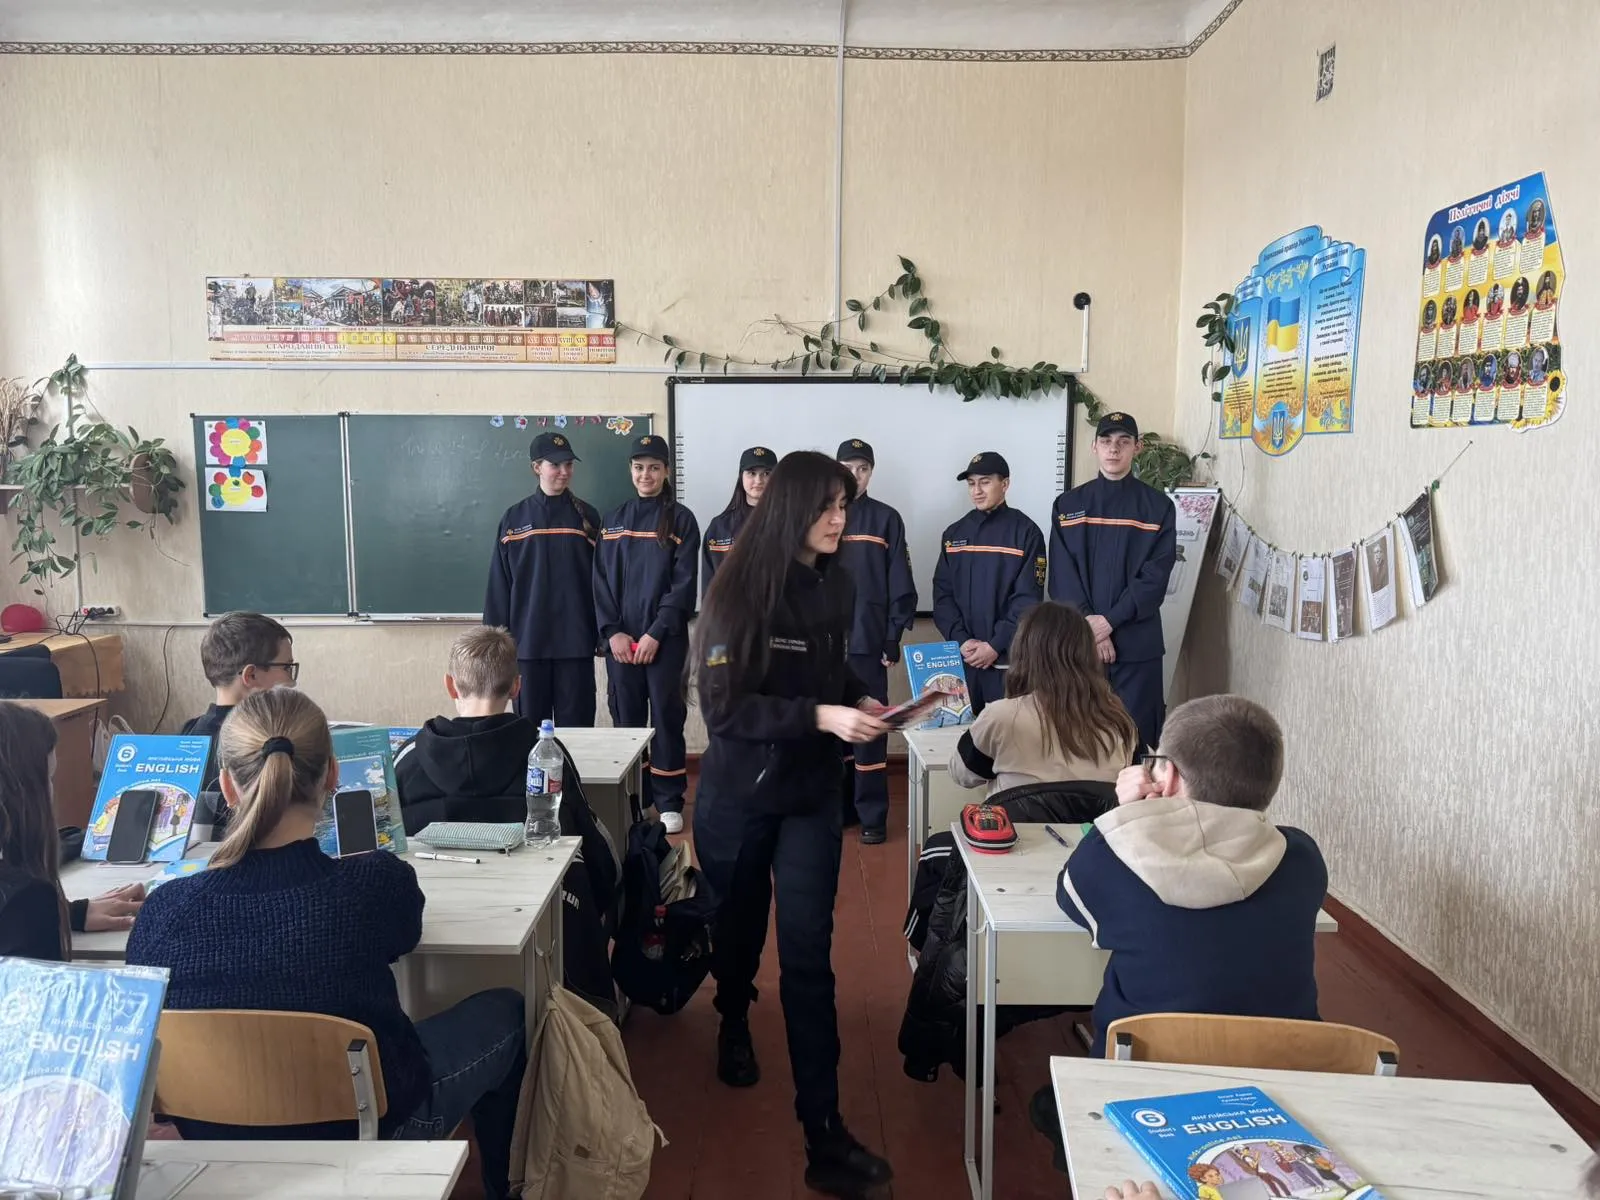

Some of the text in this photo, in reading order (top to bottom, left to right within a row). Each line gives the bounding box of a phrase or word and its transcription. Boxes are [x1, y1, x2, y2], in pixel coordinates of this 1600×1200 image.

[1448, 184, 1520, 224] Політичні діячі
[926, 659, 961, 669] ENGLISH
[135, 763, 200, 774] ENGLISH
[28, 1031, 142, 1063] ENGLISH
[1181, 1114, 1288, 1135] ENGLISH
